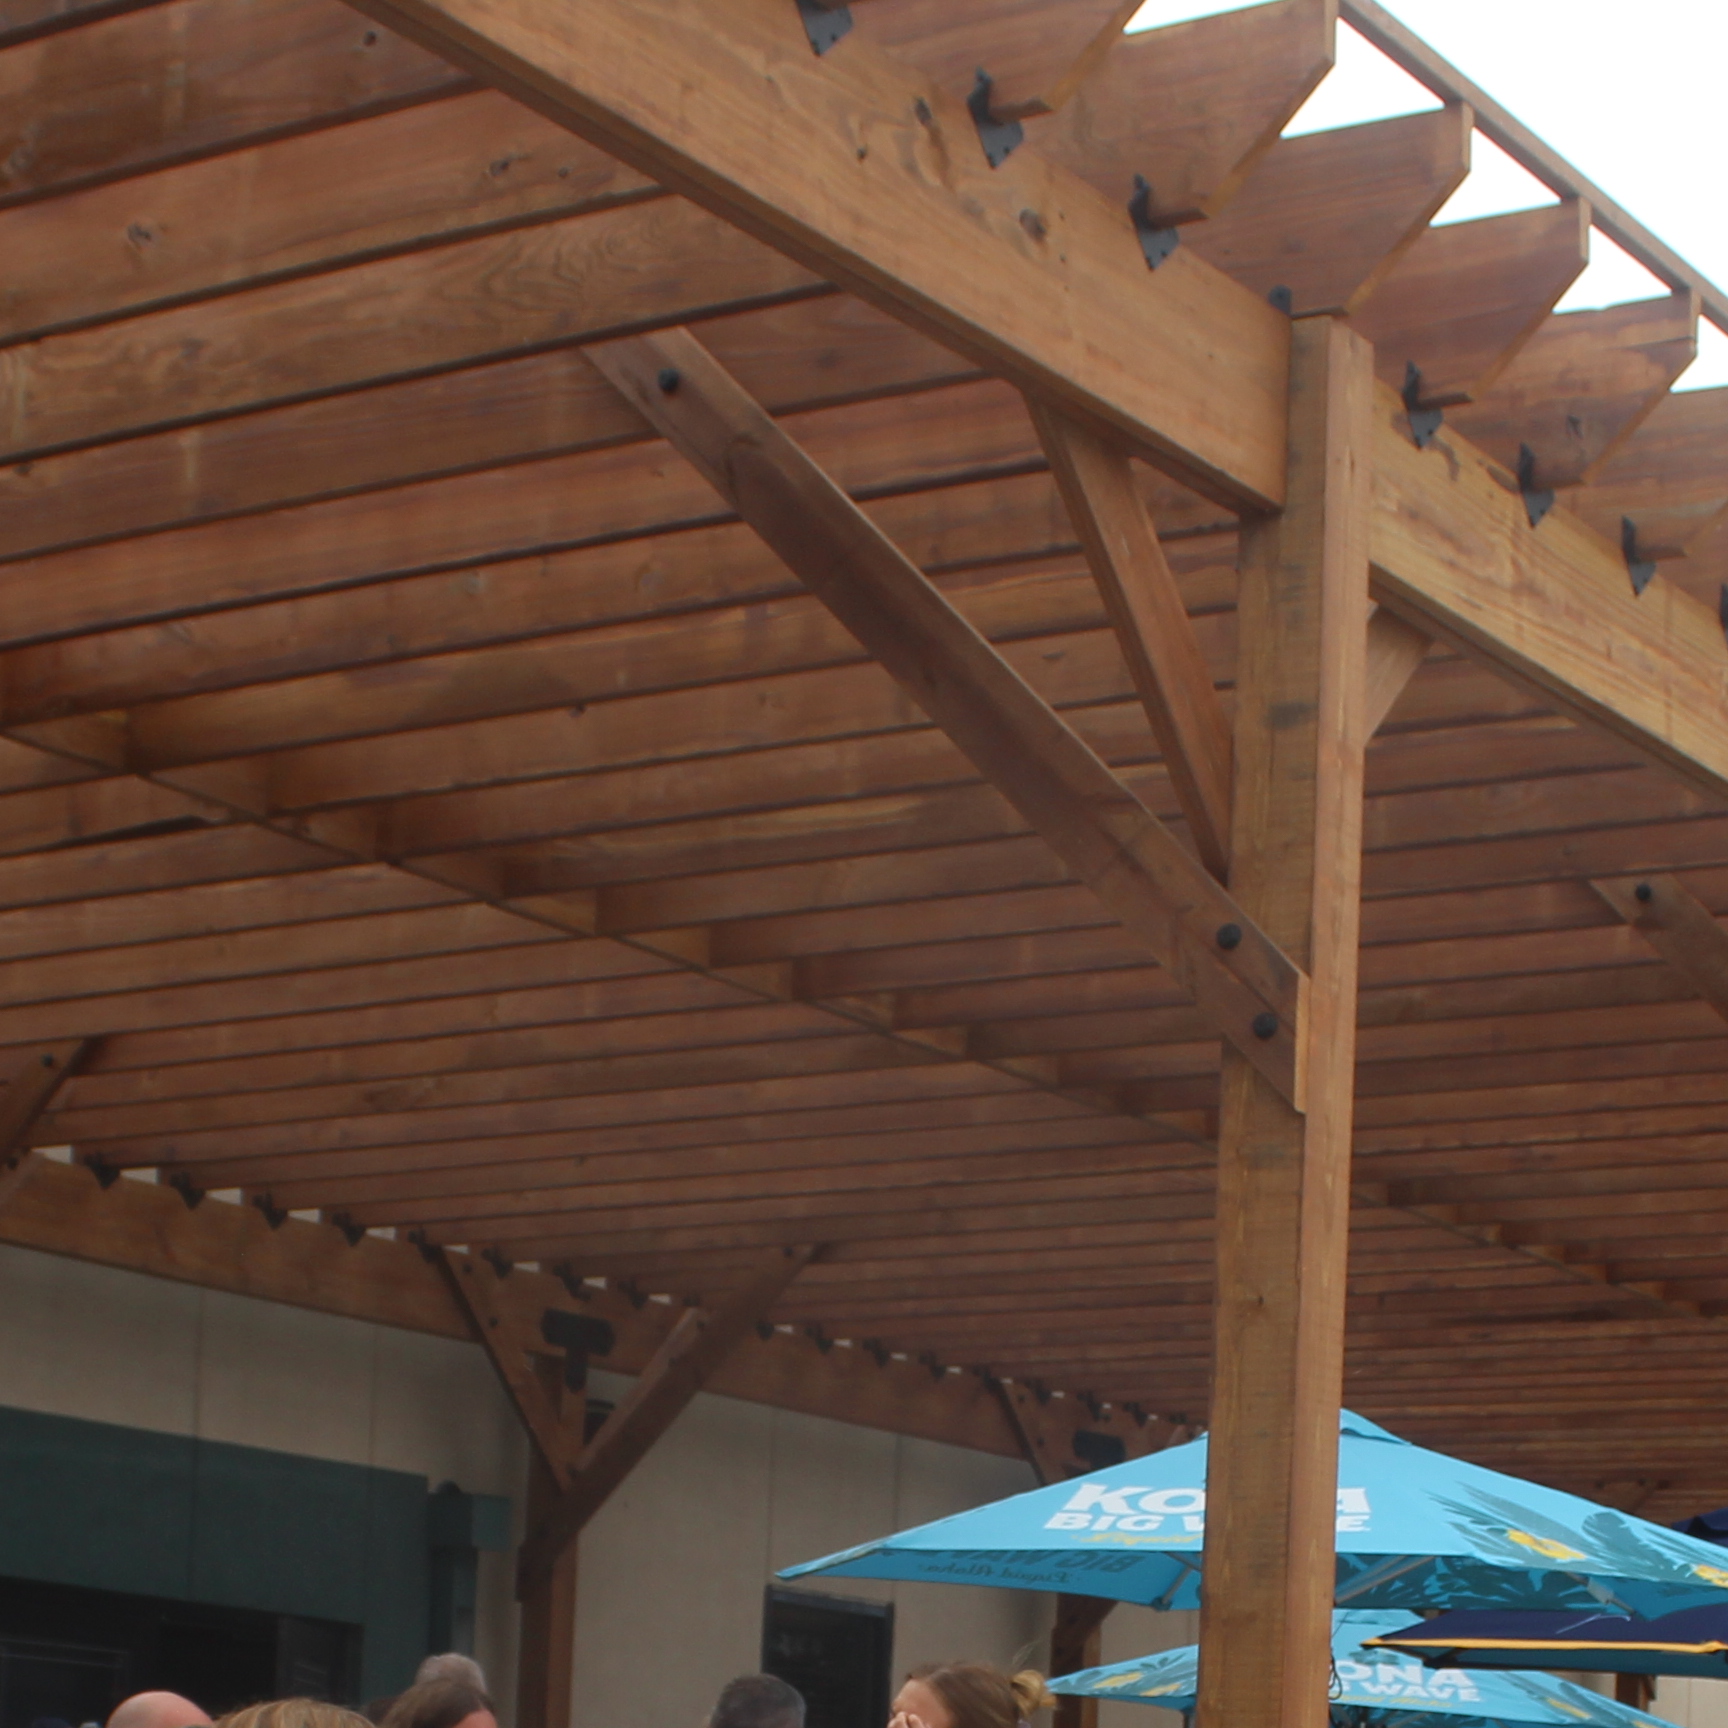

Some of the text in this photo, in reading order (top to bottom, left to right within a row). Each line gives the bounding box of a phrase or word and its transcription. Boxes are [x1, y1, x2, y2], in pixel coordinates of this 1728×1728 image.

[1061, 1483, 1370, 1517] KOA
[1043, 1512, 1165, 1532] BIG
[1332, 1659, 1475, 1687] ONA
[1360, 1680, 1482, 1702] WAVE
